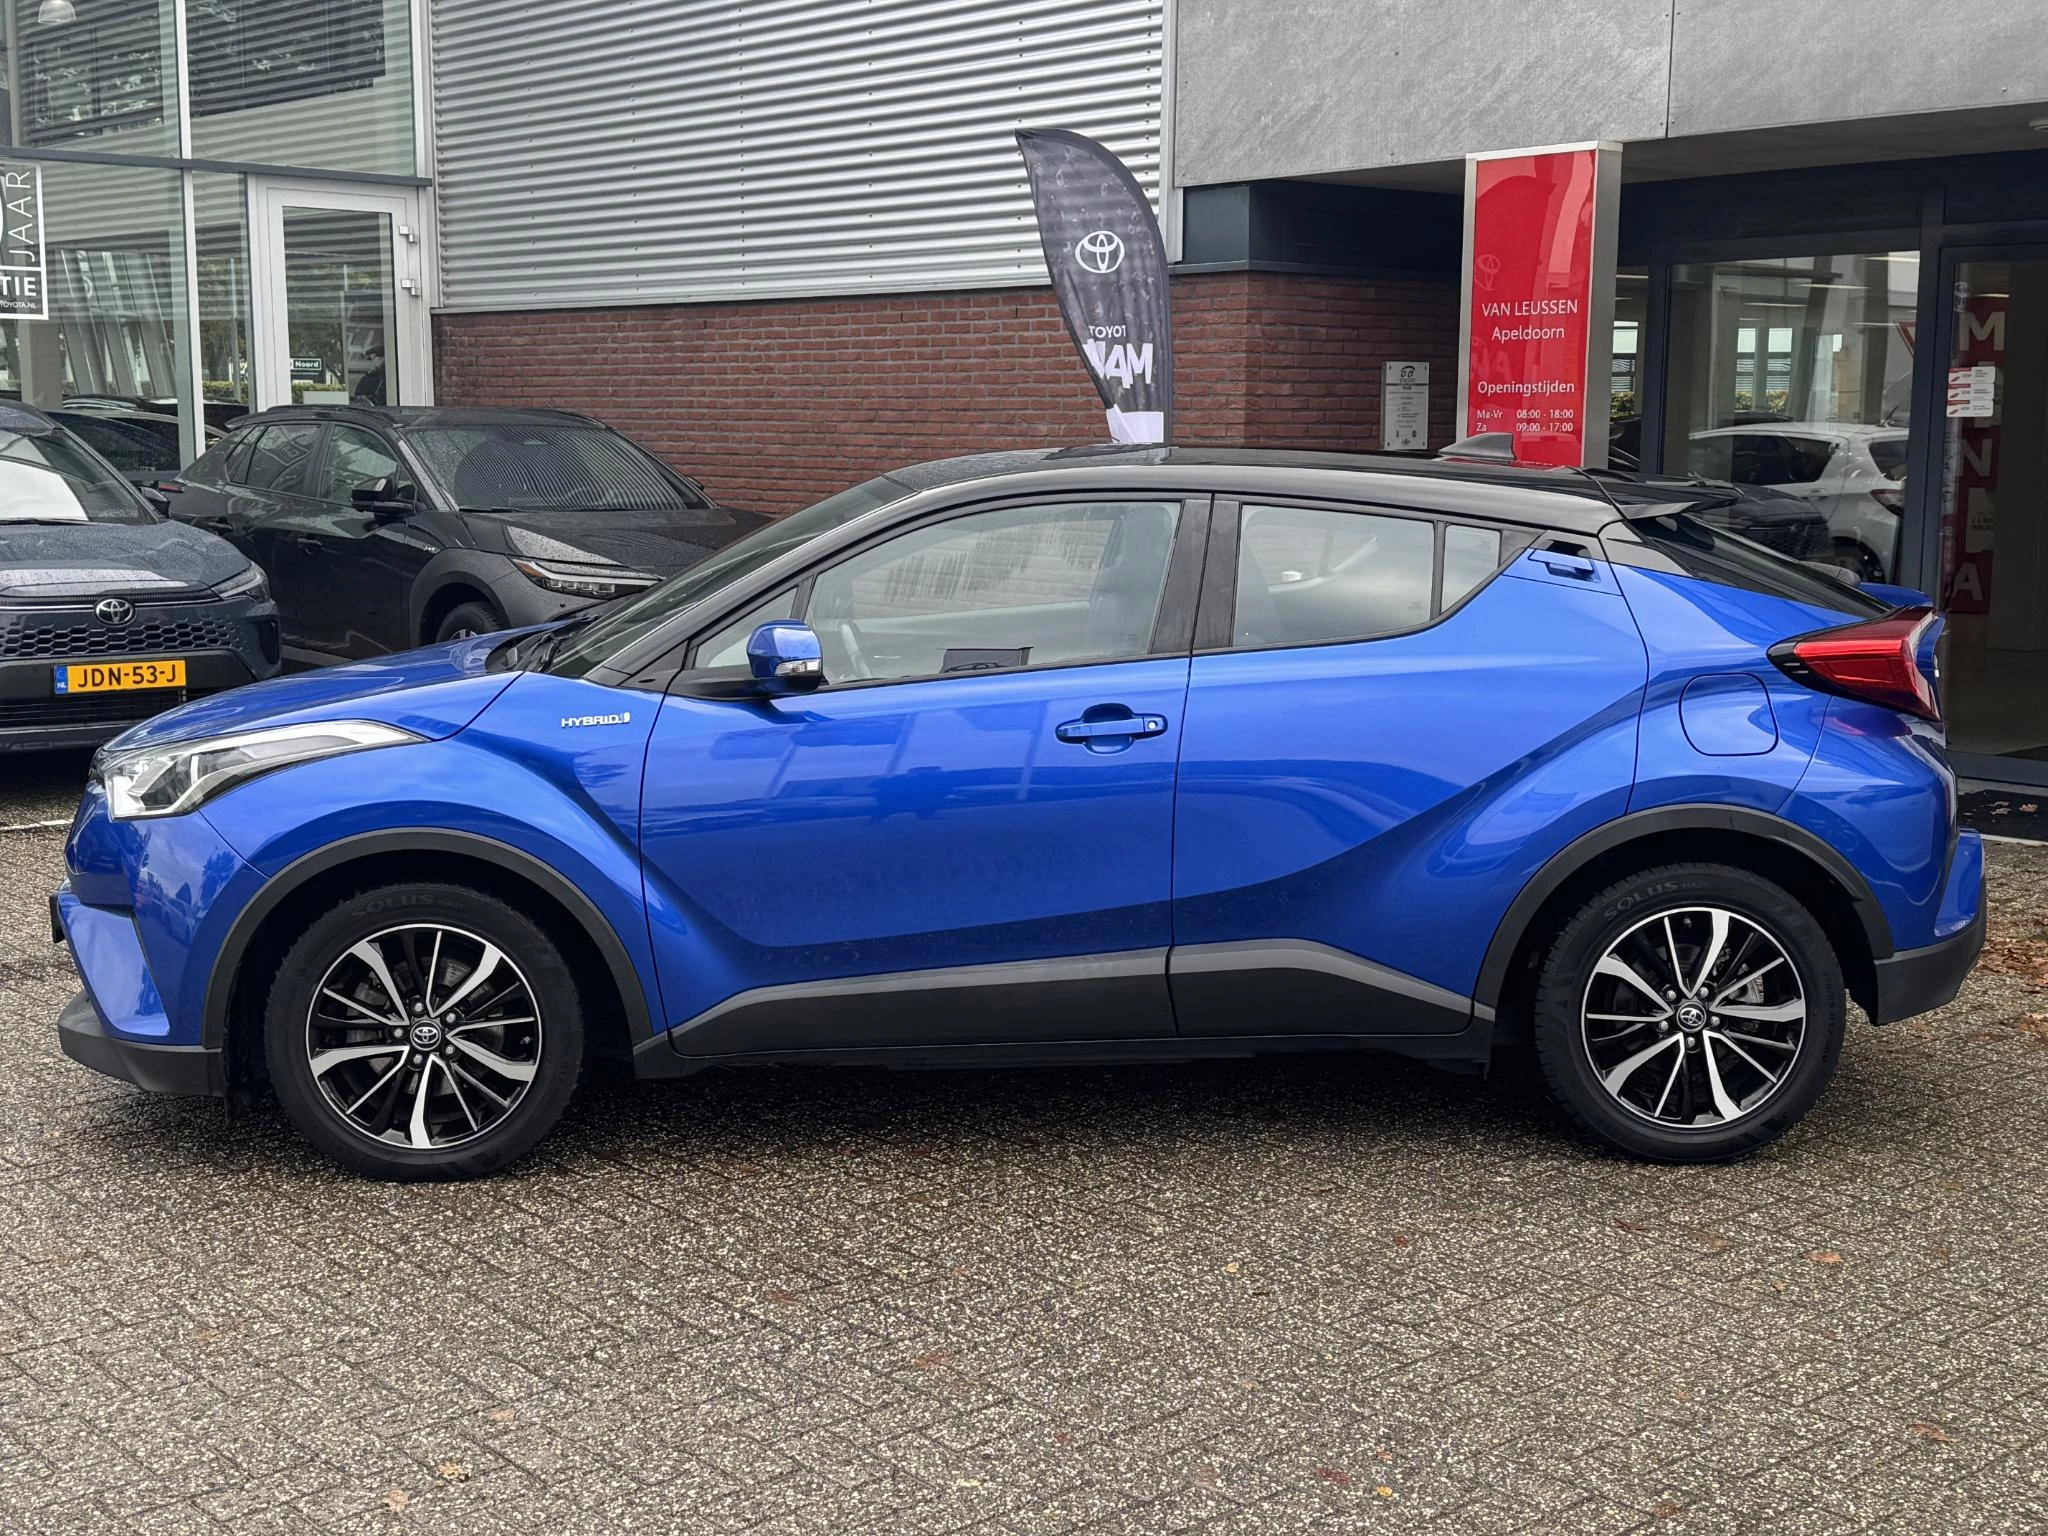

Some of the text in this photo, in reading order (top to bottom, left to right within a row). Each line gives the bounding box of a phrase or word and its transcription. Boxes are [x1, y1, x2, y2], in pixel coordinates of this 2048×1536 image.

[5, 171, 35, 262] JAAR
[0, 276, 37, 297] TIE
[1482, 299, 1578, 317] VAN LEUSSEN
[1491, 324, 1565, 344] Apeldoorn
[1477, 380, 1575, 397] Openingstijden
[1476, 409, 1503, 419] Ma-Vr
[1516, 409, 1541, 419] 08:00
[1550, 409, 1574, 419] 18:00
[1476, 422, 1487, 432] Za
[1516, 422, 1540, 432] 09:00
[1549, 422, 1573, 432] 17:00
[77, 664, 176, 688] JDN-53-J
[561, 714, 621, 727] HYBRID
[351, 894, 435, 921] SOLUS
[1604, 880, 1679, 921] SOLUS
